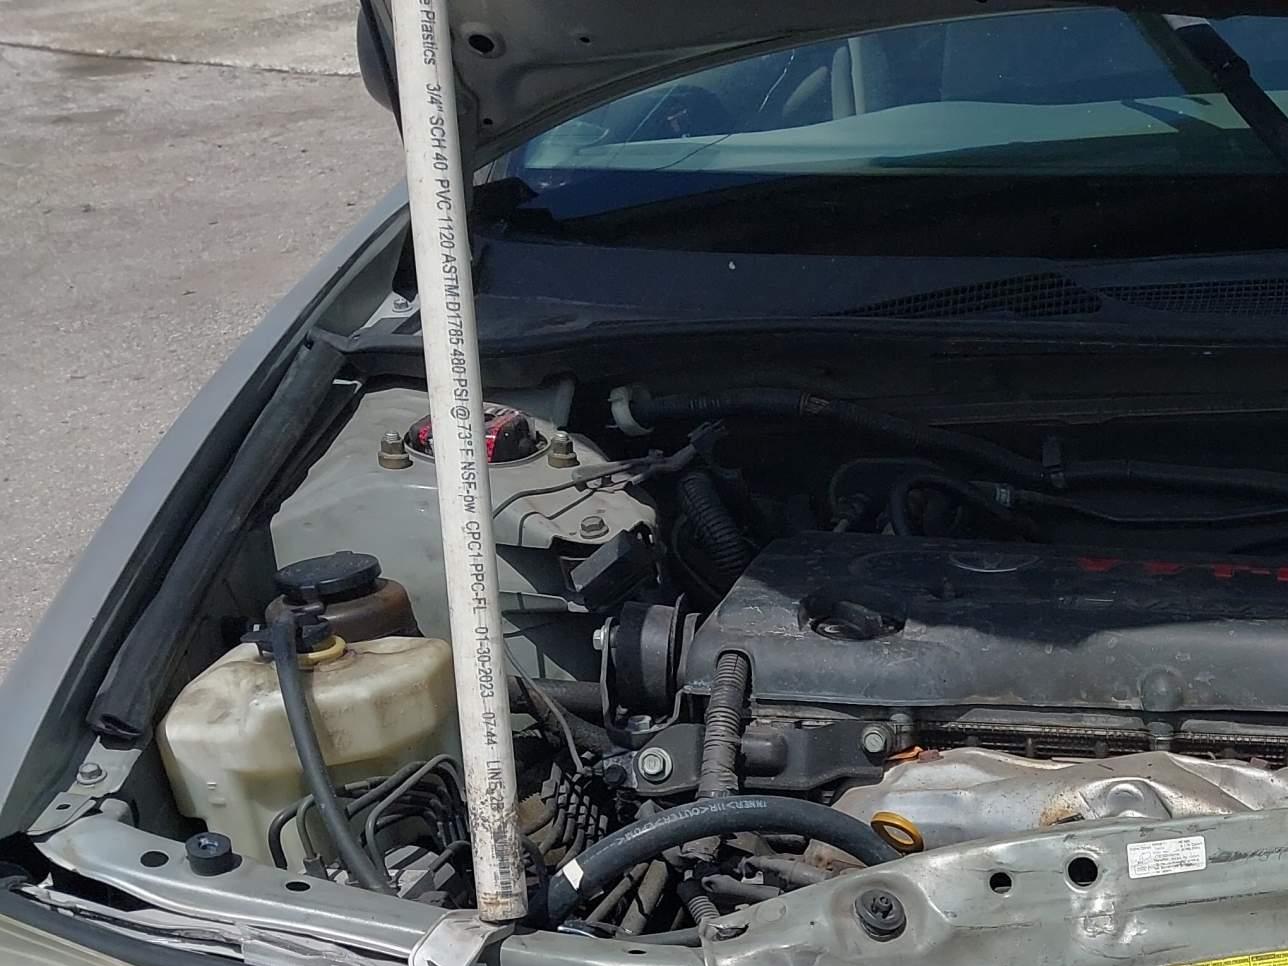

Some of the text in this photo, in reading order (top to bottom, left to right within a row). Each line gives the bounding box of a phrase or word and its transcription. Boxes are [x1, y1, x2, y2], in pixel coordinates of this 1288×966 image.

[420, 9, 439, 65] Plastics
[426, 82, 444, 112] 3/4"
[429, 115, 447, 149] SCH
[433, 152, 449, 171] 40
[435, 178, 452, 211] PVC
[438, 215, 456, 249] 1120
[441, 253, 460, 298] ASTM
[445, 301, 465, 346] D1785
[451, 348, 467, 374] 480
[453, 378, 470, 402] PSI
[450, 405, 471, 421] @
[458, 461, 477, 514] NSF-pw
[465, 520, 484, 558] CPC1
[470, 563, 488, 614] PPC-FL
[474, 626, 495, 698] 01-30-2023
